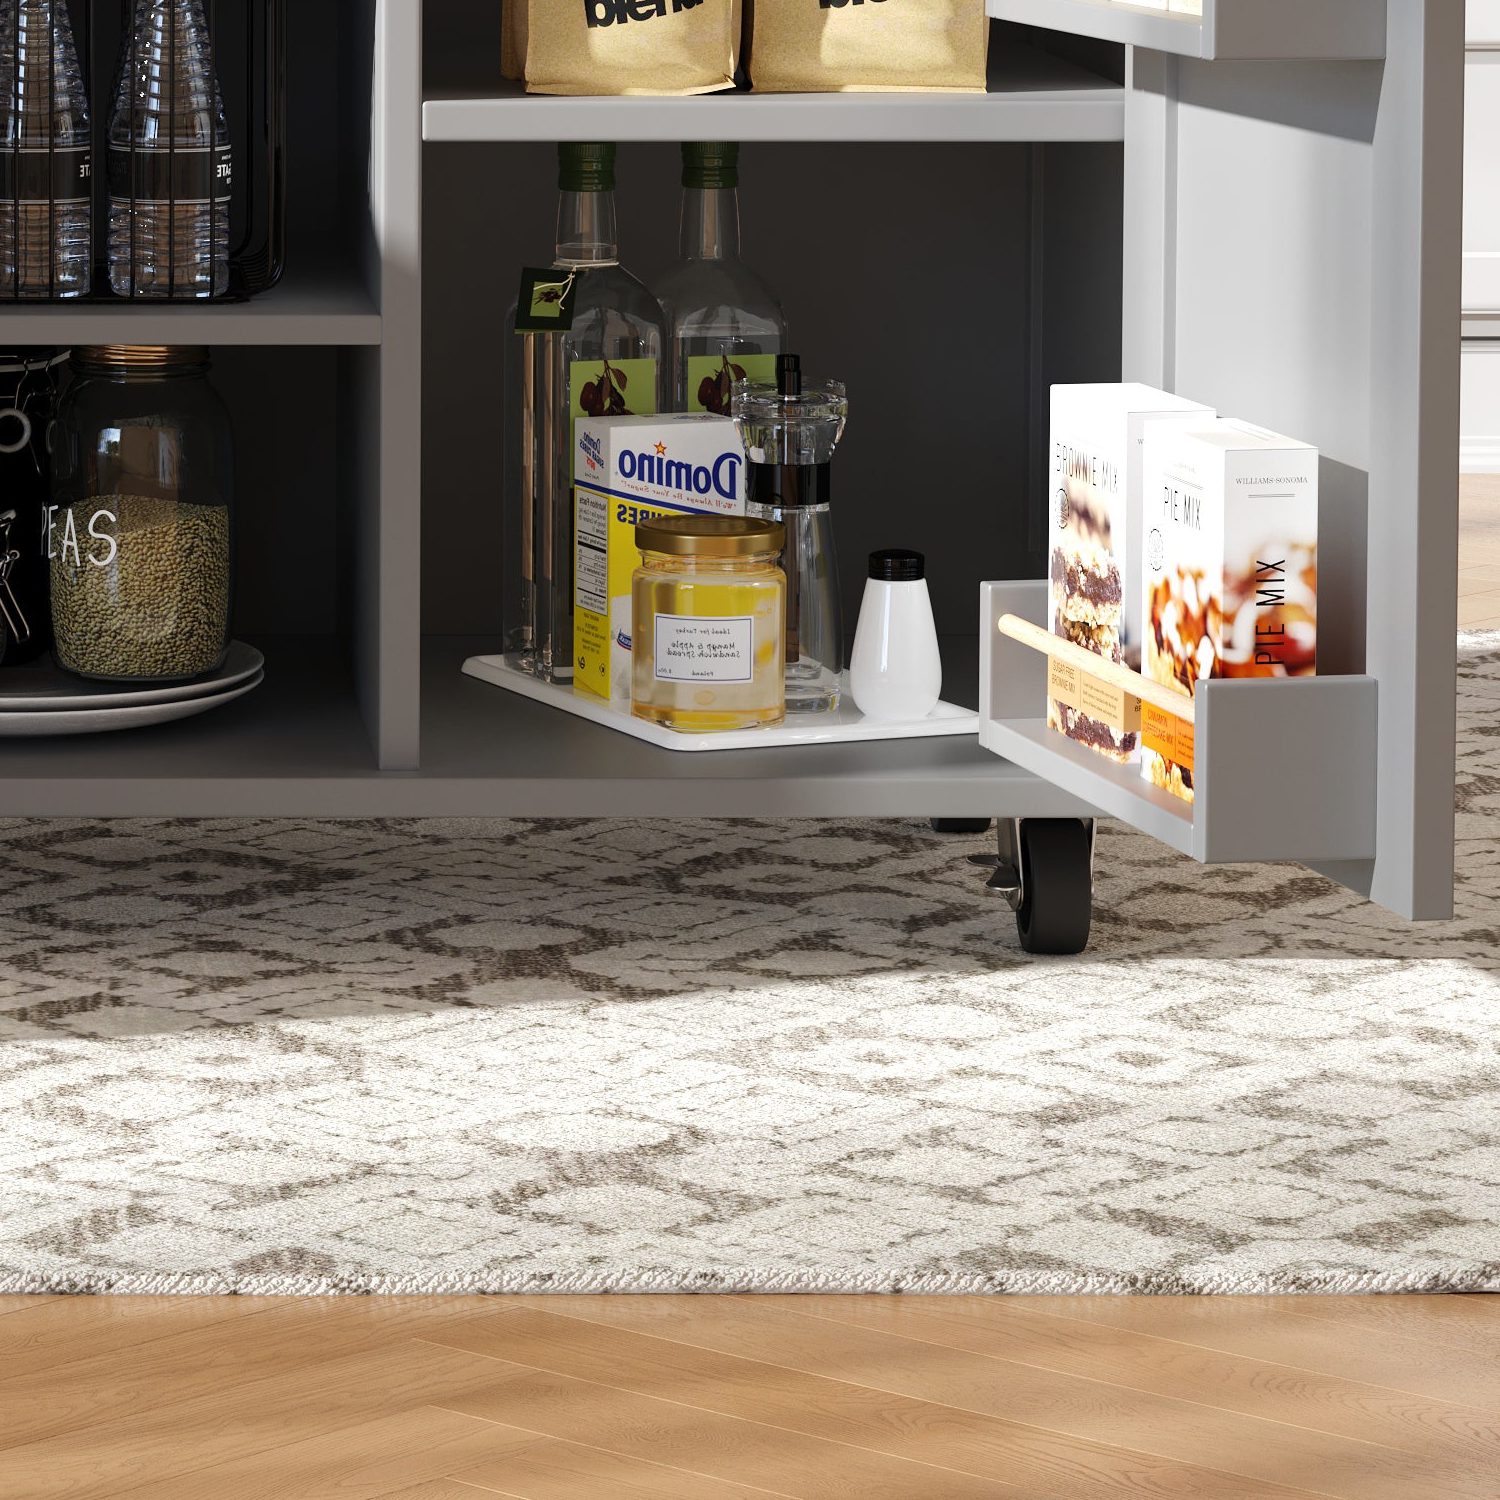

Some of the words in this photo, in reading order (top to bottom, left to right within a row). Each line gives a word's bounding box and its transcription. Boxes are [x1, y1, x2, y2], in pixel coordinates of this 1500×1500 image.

[1056, 443, 1097, 487] BROWNIE
[1101, 460, 1118, 494] MIX
[1163, 486, 1178, 522] PIE
[1183, 494, 1201, 531] MIX
[41, 501, 117, 567] PEAS
[1256, 559, 1285, 607] MIX
[1255, 624, 1285, 665] PIE
